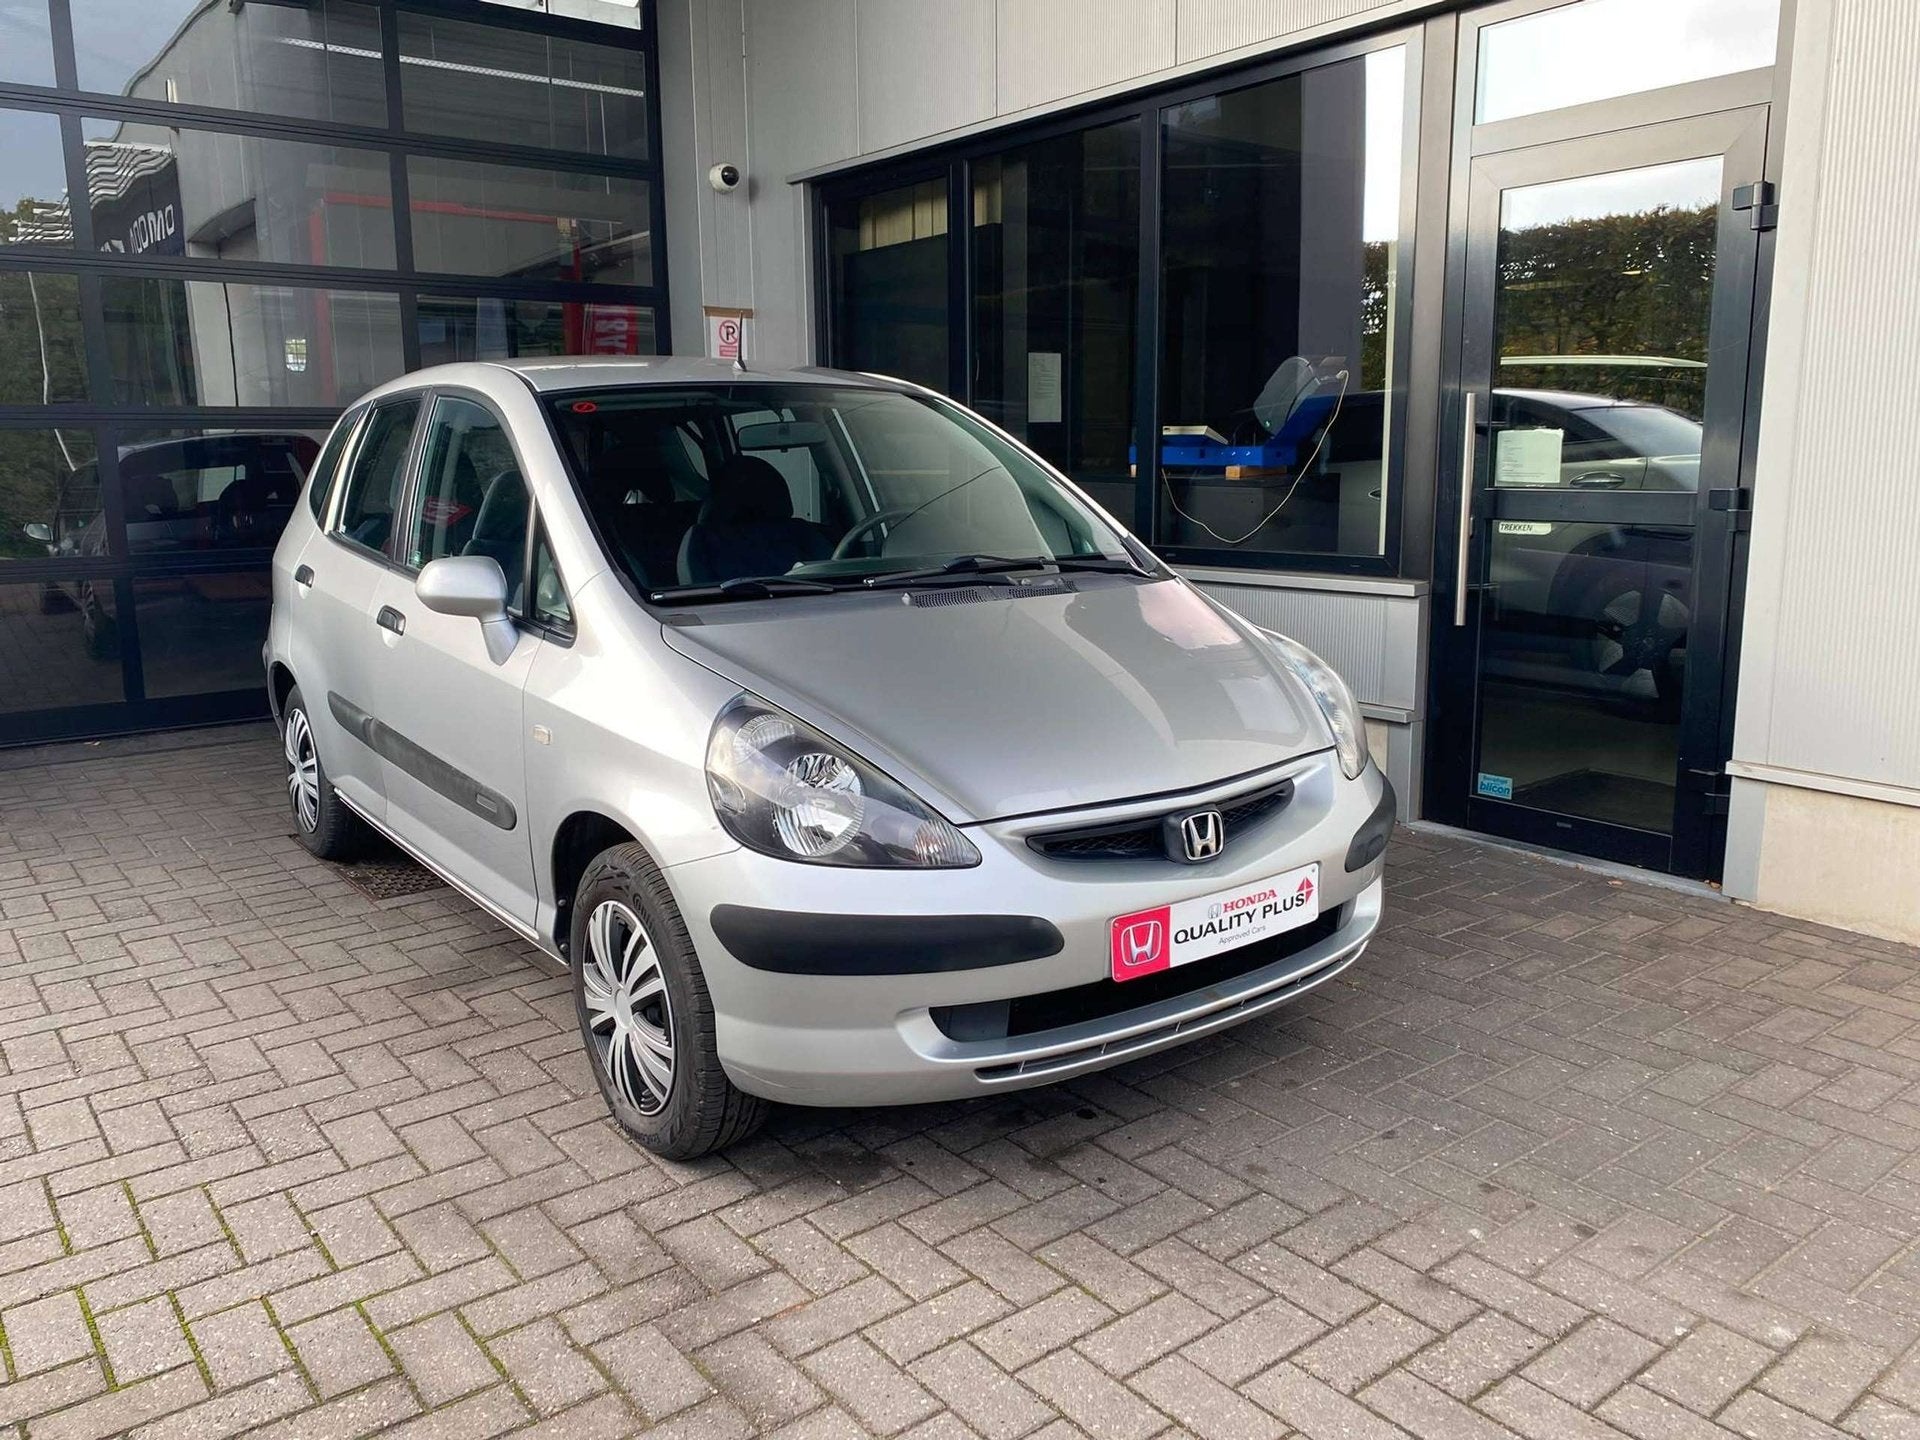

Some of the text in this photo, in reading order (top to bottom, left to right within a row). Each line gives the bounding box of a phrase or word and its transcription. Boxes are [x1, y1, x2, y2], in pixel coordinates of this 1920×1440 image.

[1500, 523, 1533, 532] TREKKEN
[1222, 889, 1277, 913] HONDA
[1174, 893, 1305, 944] QUALITY PLUS
[1218, 925, 1266, 945] Approved Cars
